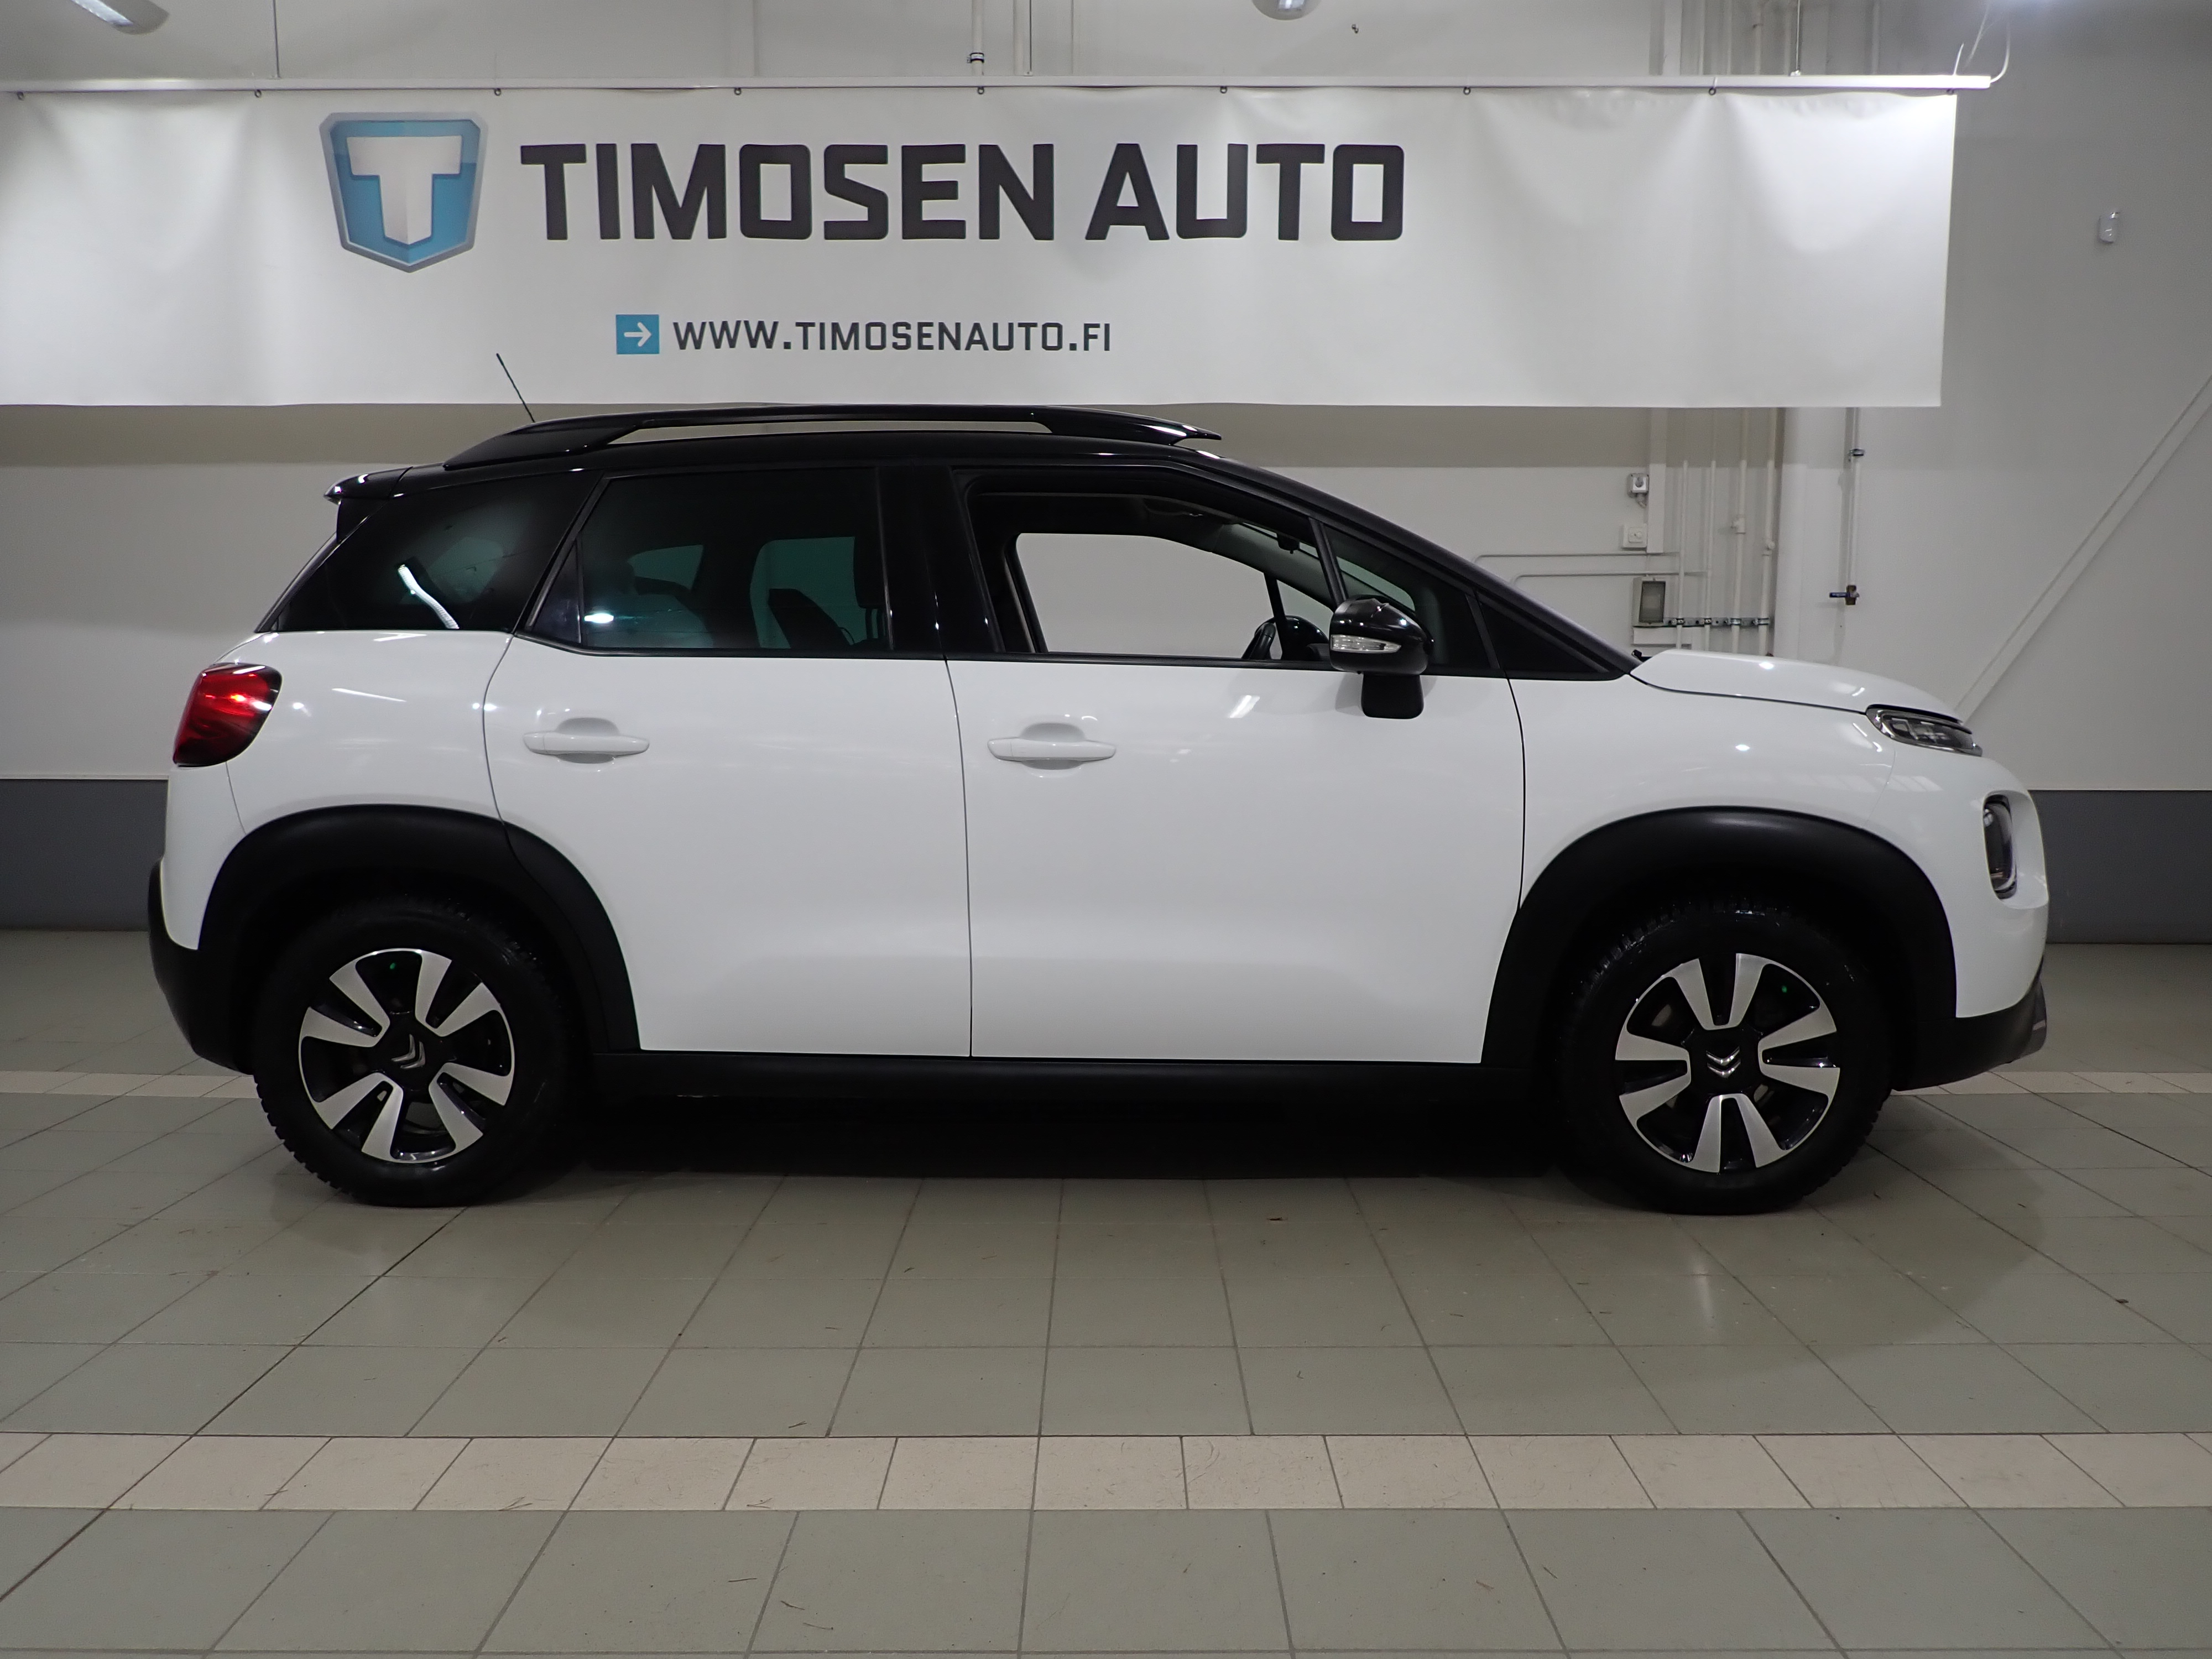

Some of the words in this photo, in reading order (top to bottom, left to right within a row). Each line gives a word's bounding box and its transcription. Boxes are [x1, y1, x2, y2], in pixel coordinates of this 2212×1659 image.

[346, 135, 462, 244] T
[520, 143, 1054, 241] TIMOSEN
[1085, 143, 1404, 241] AUTO
[673, 320, 1110, 351] WWW.TIMOSENAUTO.FI
